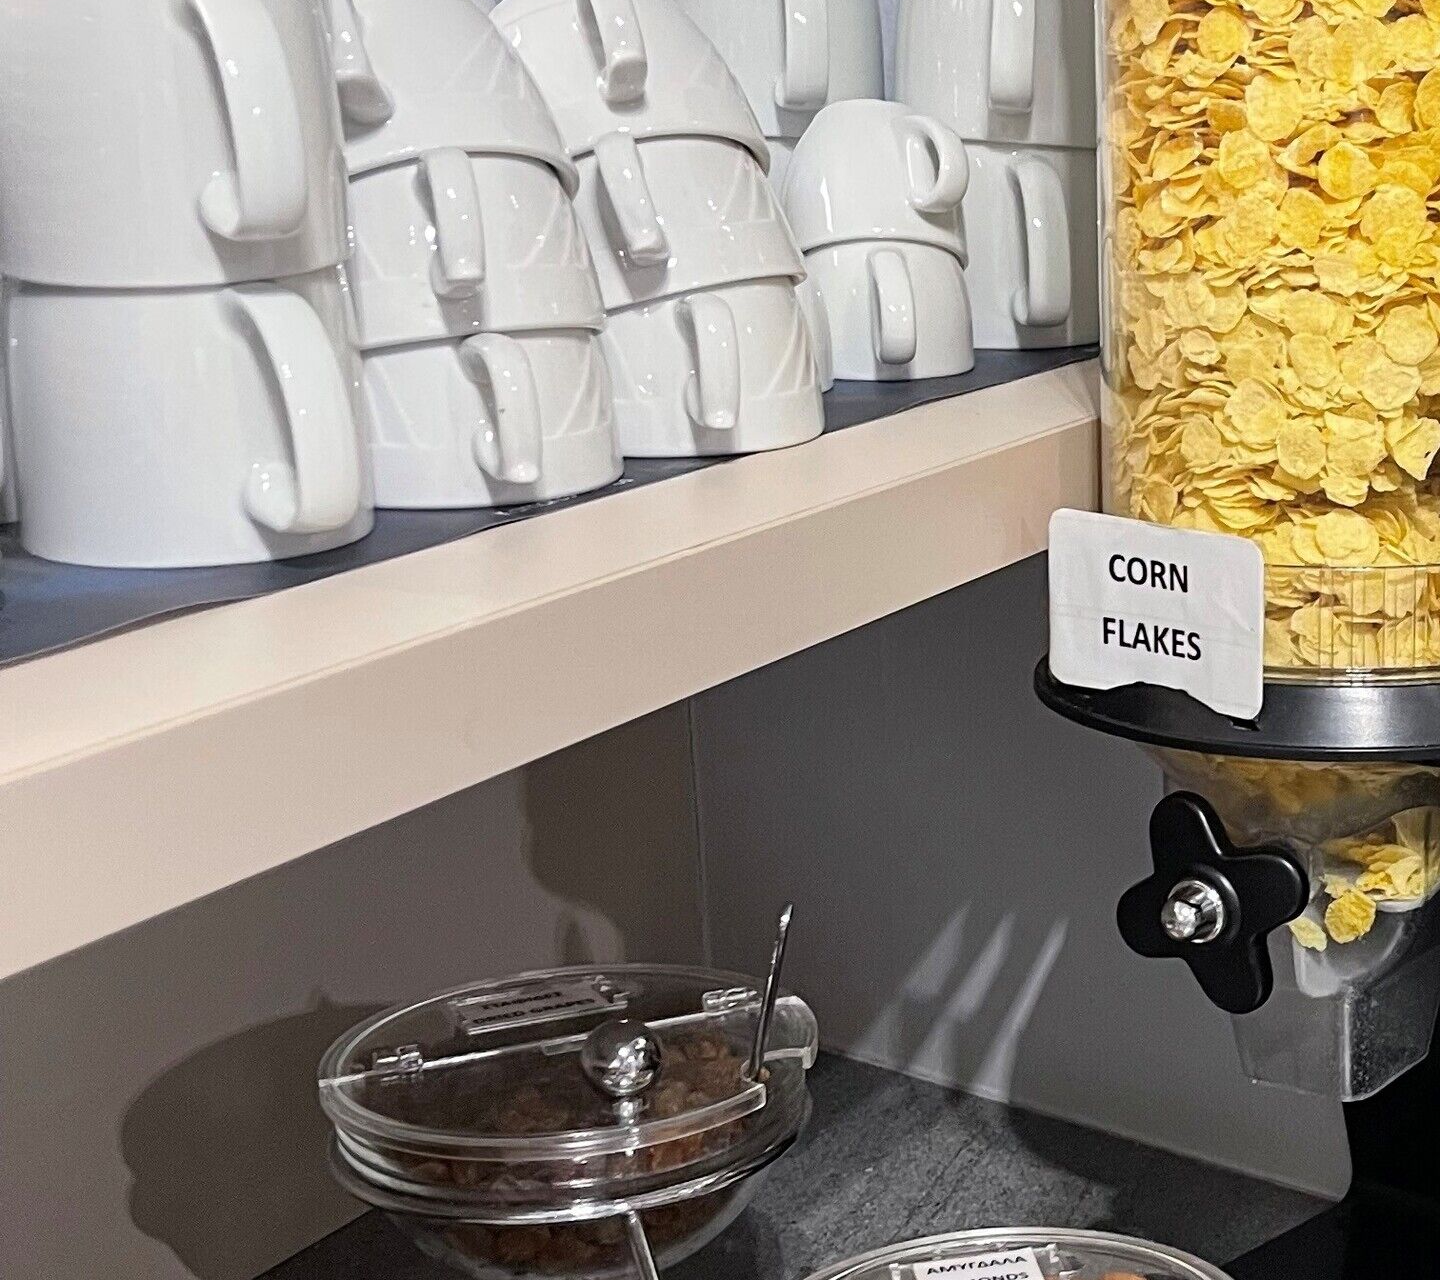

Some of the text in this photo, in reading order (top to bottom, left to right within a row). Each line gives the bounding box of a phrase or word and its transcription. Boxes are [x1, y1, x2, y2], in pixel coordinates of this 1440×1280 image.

[1108, 554, 1189, 593] CORN
[1102, 616, 1202, 661] FLAKES
[926, 1255, 1028, 1275] ΑΜΥΓΔΑΛΑ
